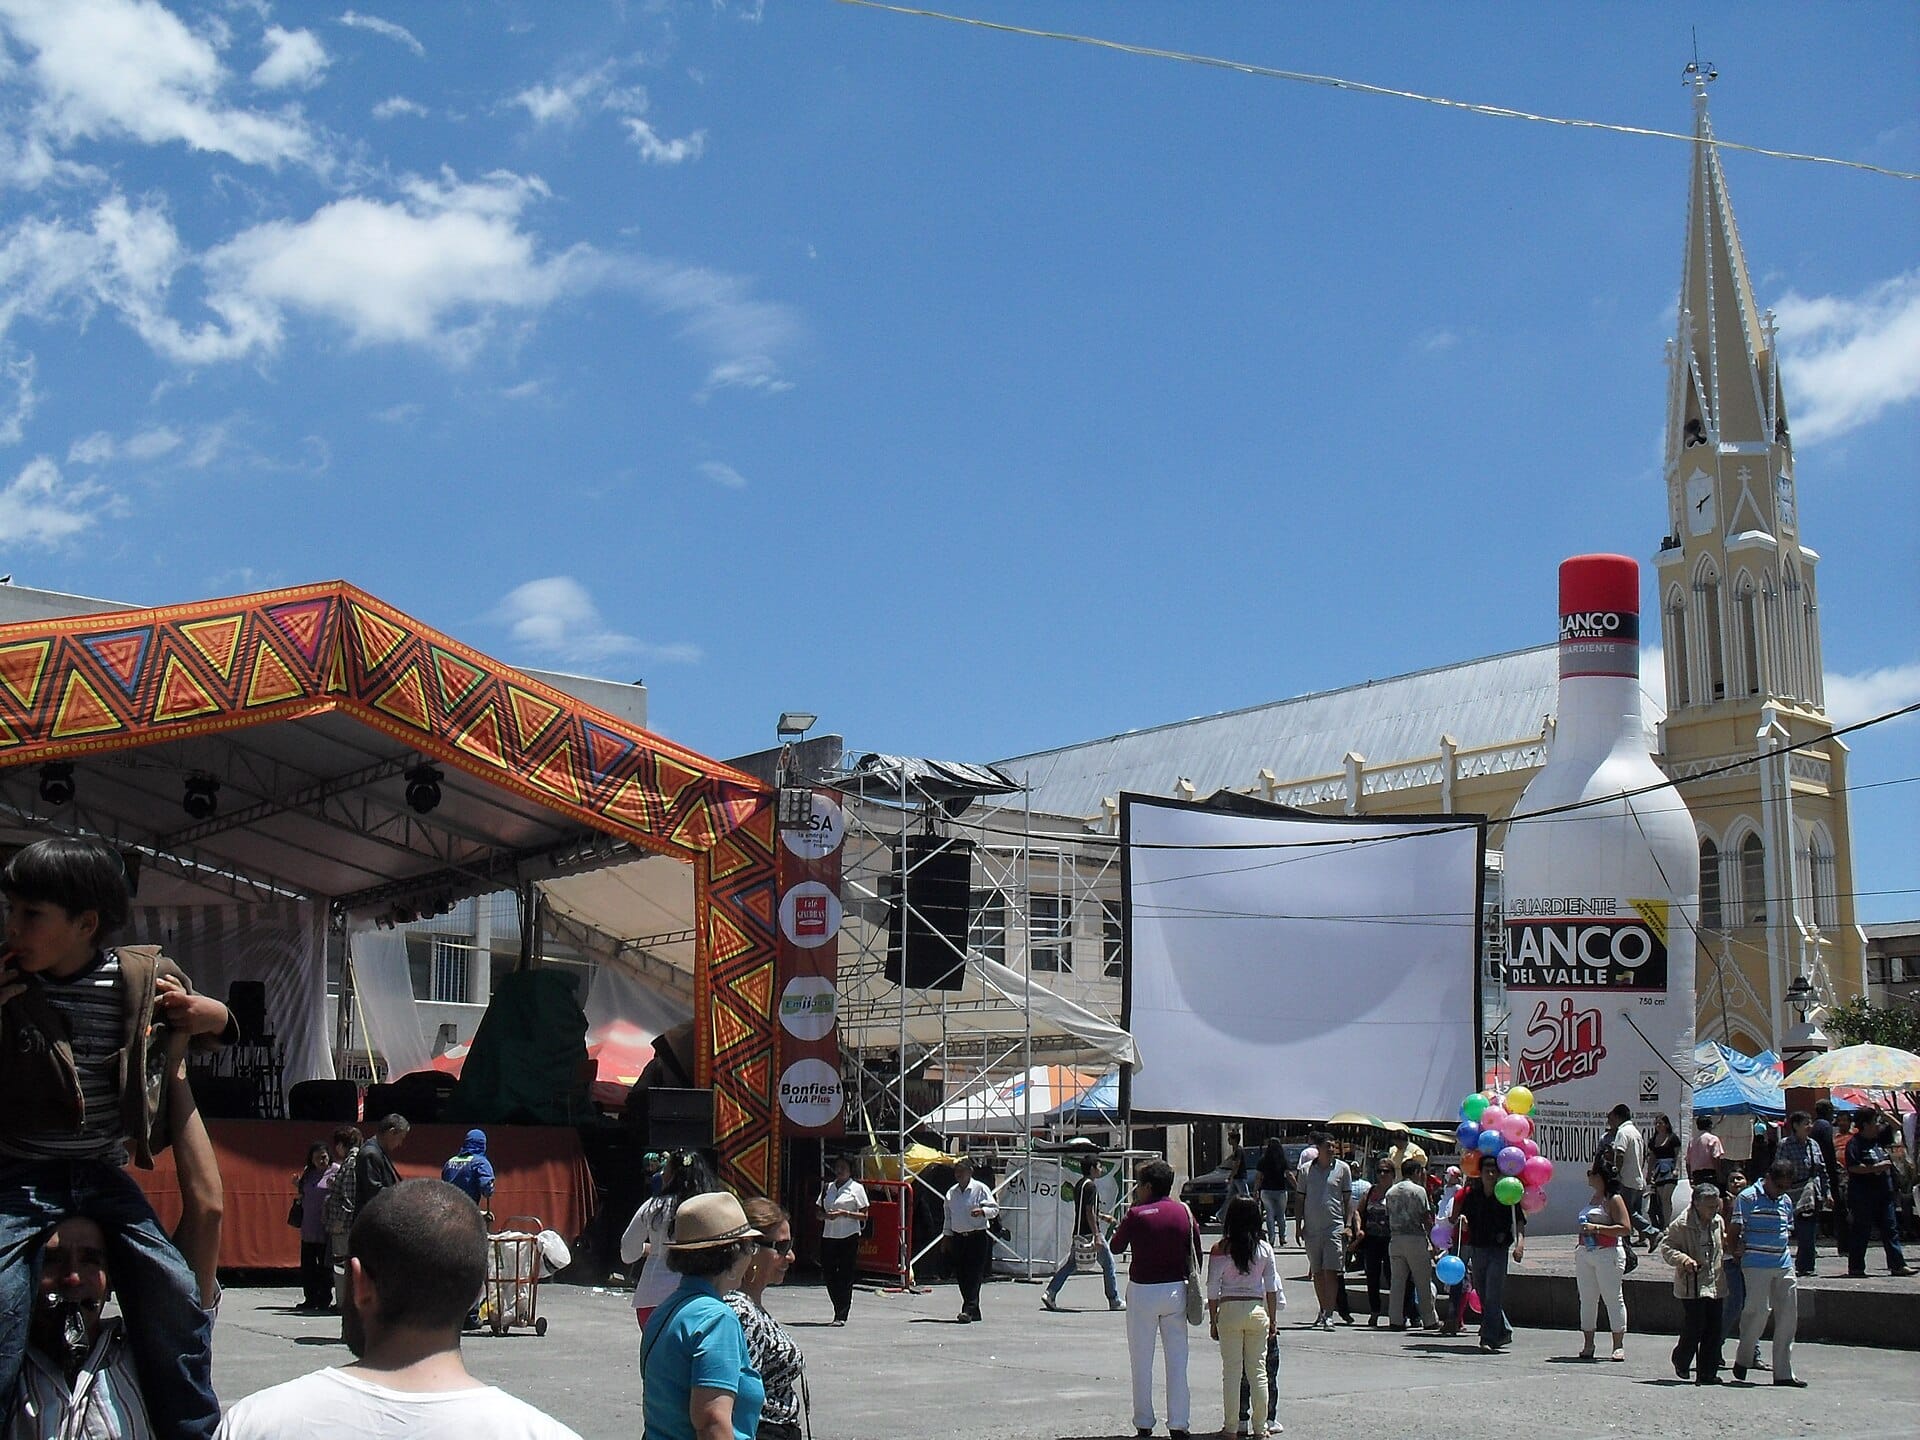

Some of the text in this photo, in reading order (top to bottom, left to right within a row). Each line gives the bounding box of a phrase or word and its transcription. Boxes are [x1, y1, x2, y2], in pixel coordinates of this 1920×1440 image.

[1560, 612, 1620, 632] LANCO
[1573, 630, 1604, 638] VALLE
[810, 815, 833, 832] SA
[1504, 926, 1652, 968] LANCO
[1512, 968, 1608, 985] DEL VALLE
[1639, 997, 1652, 1006] 750
[1521, 998, 1599, 1061] Sin
[781, 1083, 841, 1095] Bonfiest
[788, 1095, 831, 1104] LUA Plus
[1540, 1124, 1548, 1158] ES
